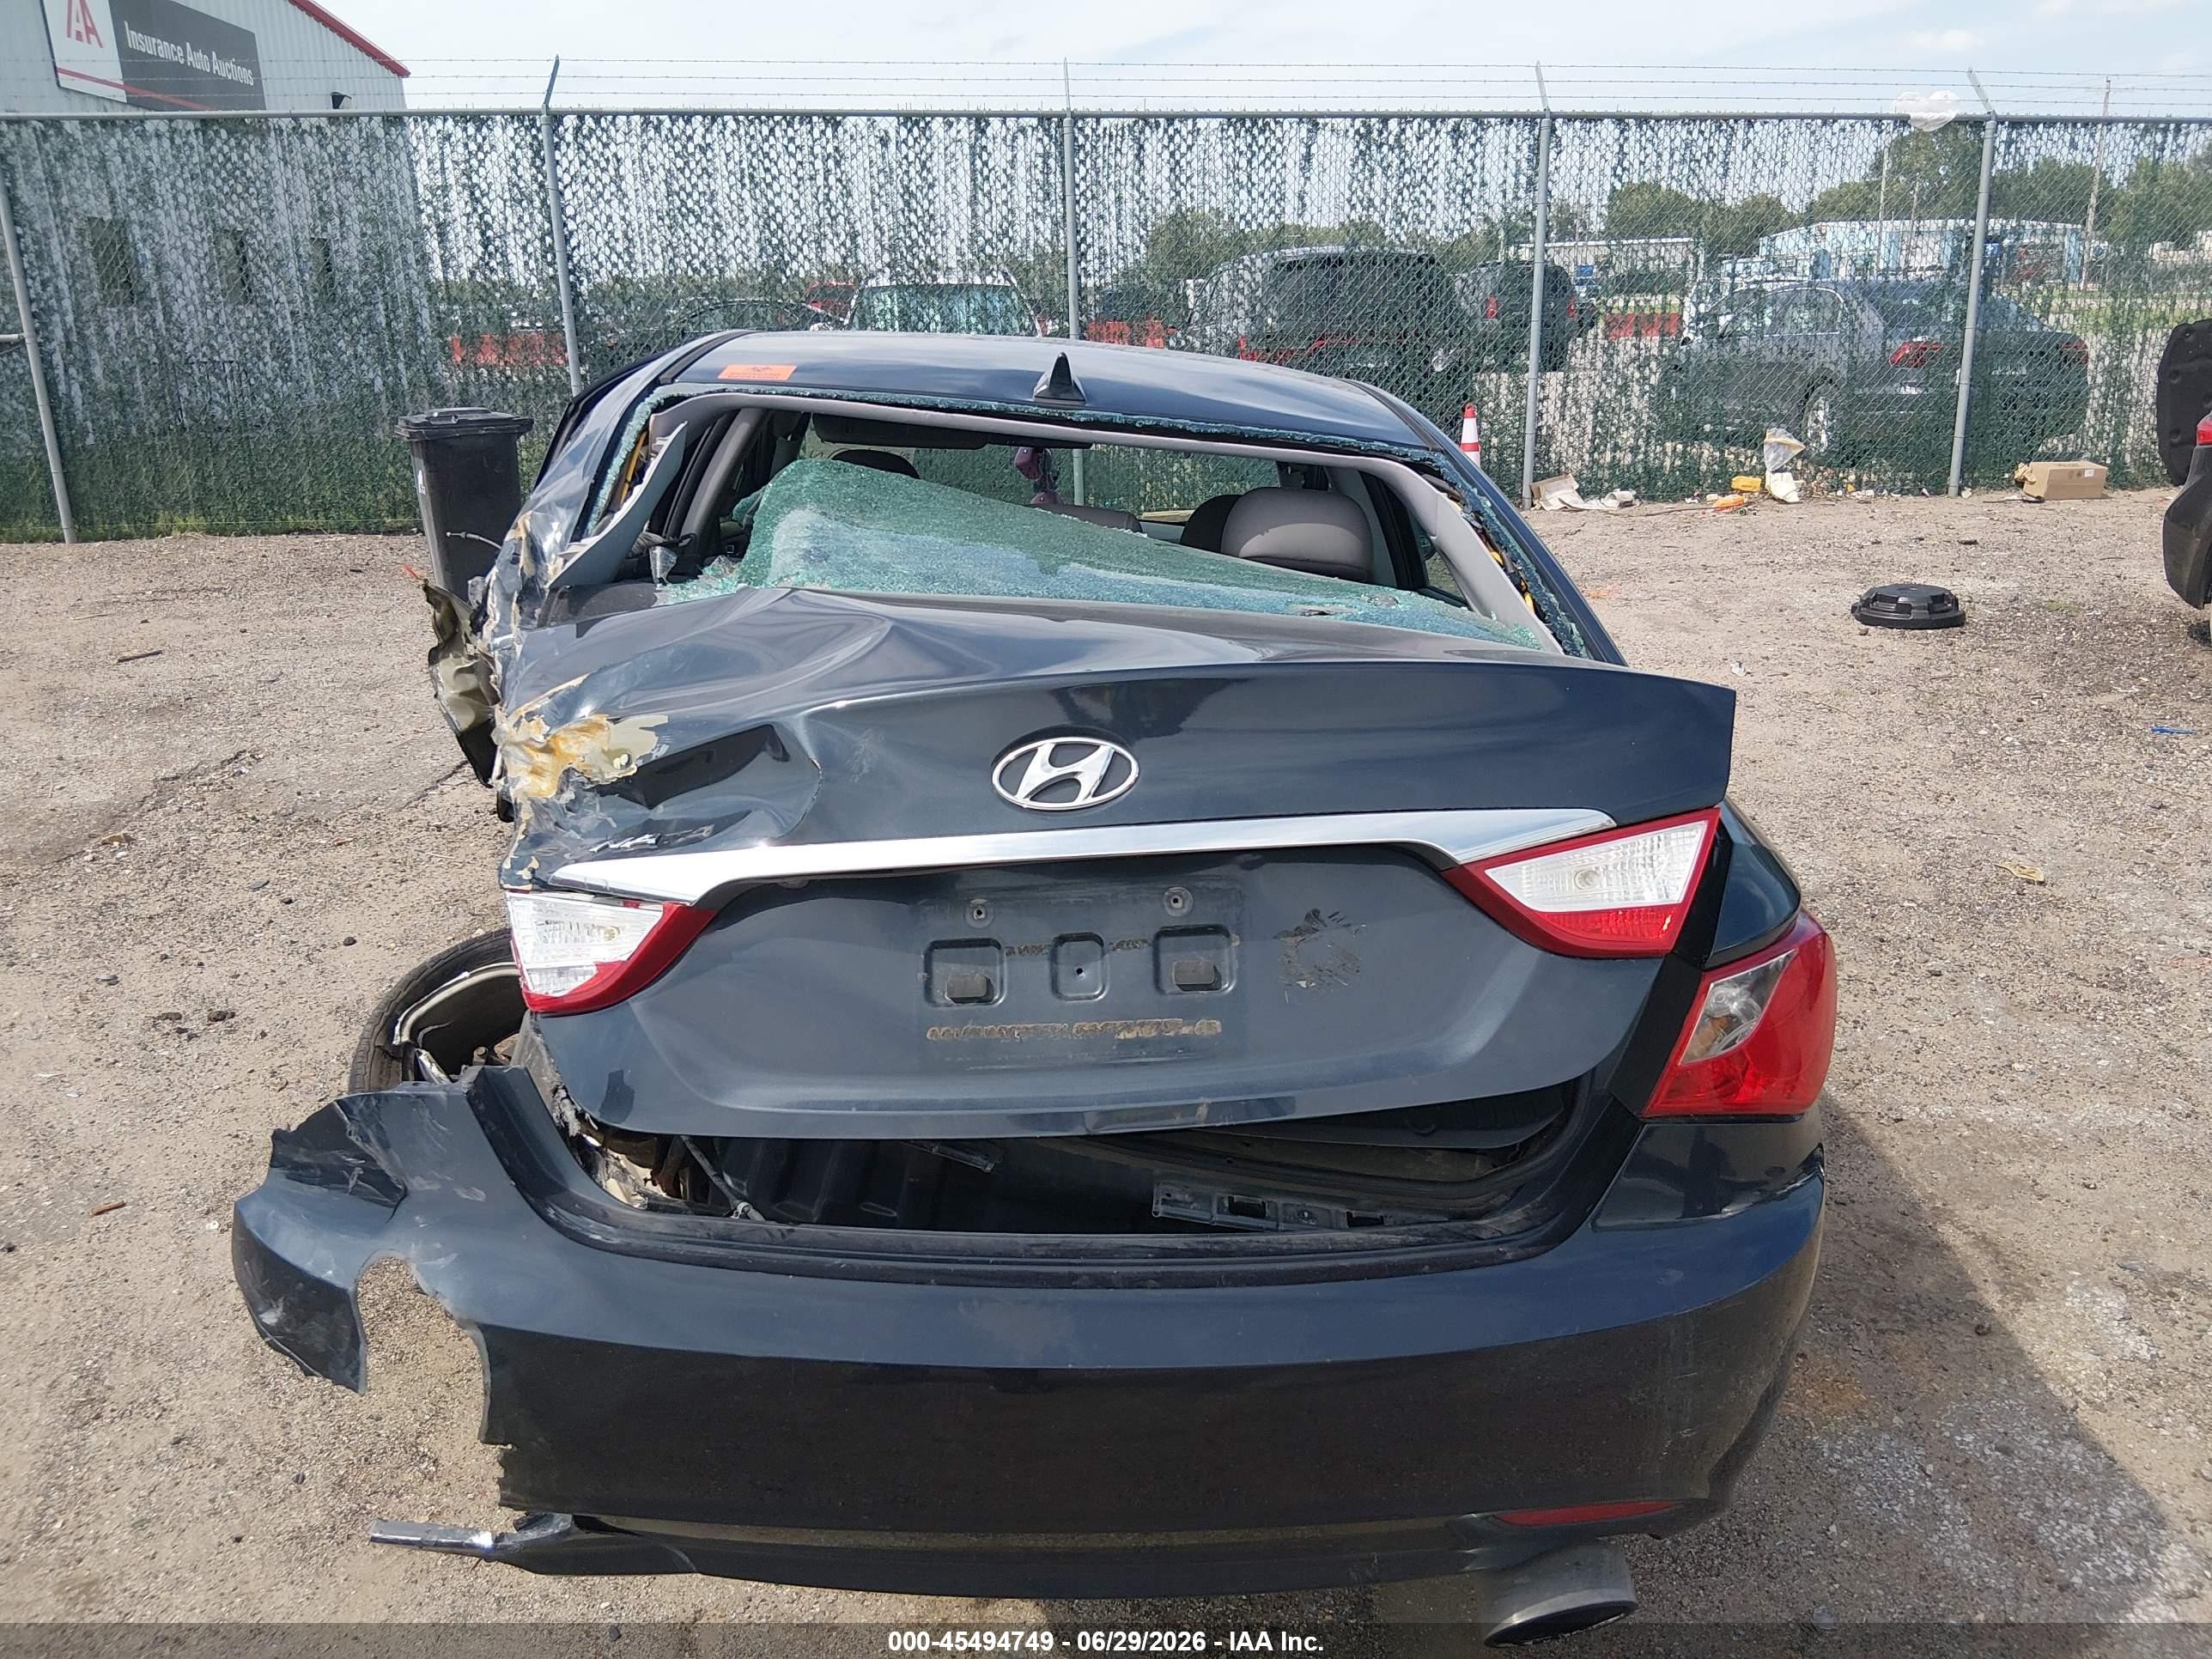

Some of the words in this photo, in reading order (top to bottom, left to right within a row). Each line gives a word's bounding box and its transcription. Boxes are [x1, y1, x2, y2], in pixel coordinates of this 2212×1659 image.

[124, 21, 185, 64] Insurance
[185, 42, 210, 73] Auto
[212, 51, 254, 86] Auctions
